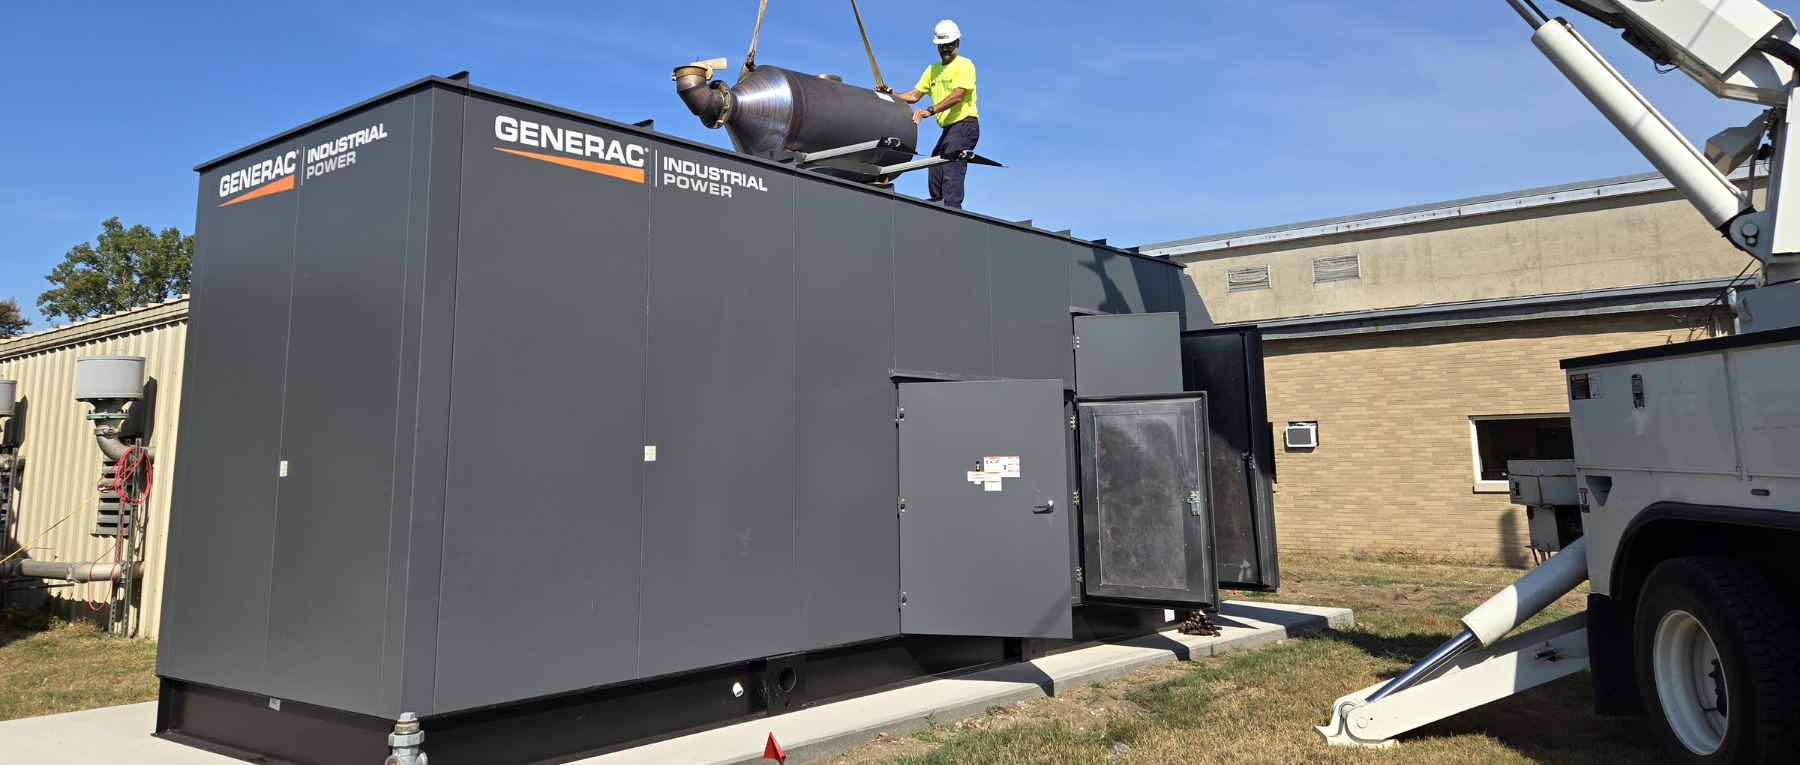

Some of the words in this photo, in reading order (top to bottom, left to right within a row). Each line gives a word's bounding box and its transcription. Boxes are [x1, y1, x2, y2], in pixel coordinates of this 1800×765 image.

[307, 123, 388, 164] INDUSTRIAL
[494, 115, 644, 167] GENERAC
[219, 150, 296, 198] GENERAC
[306, 151, 357, 180] POWER
[663, 156, 768, 192] INDUSTRIAL
[663, 172, 733, 198] POWER
